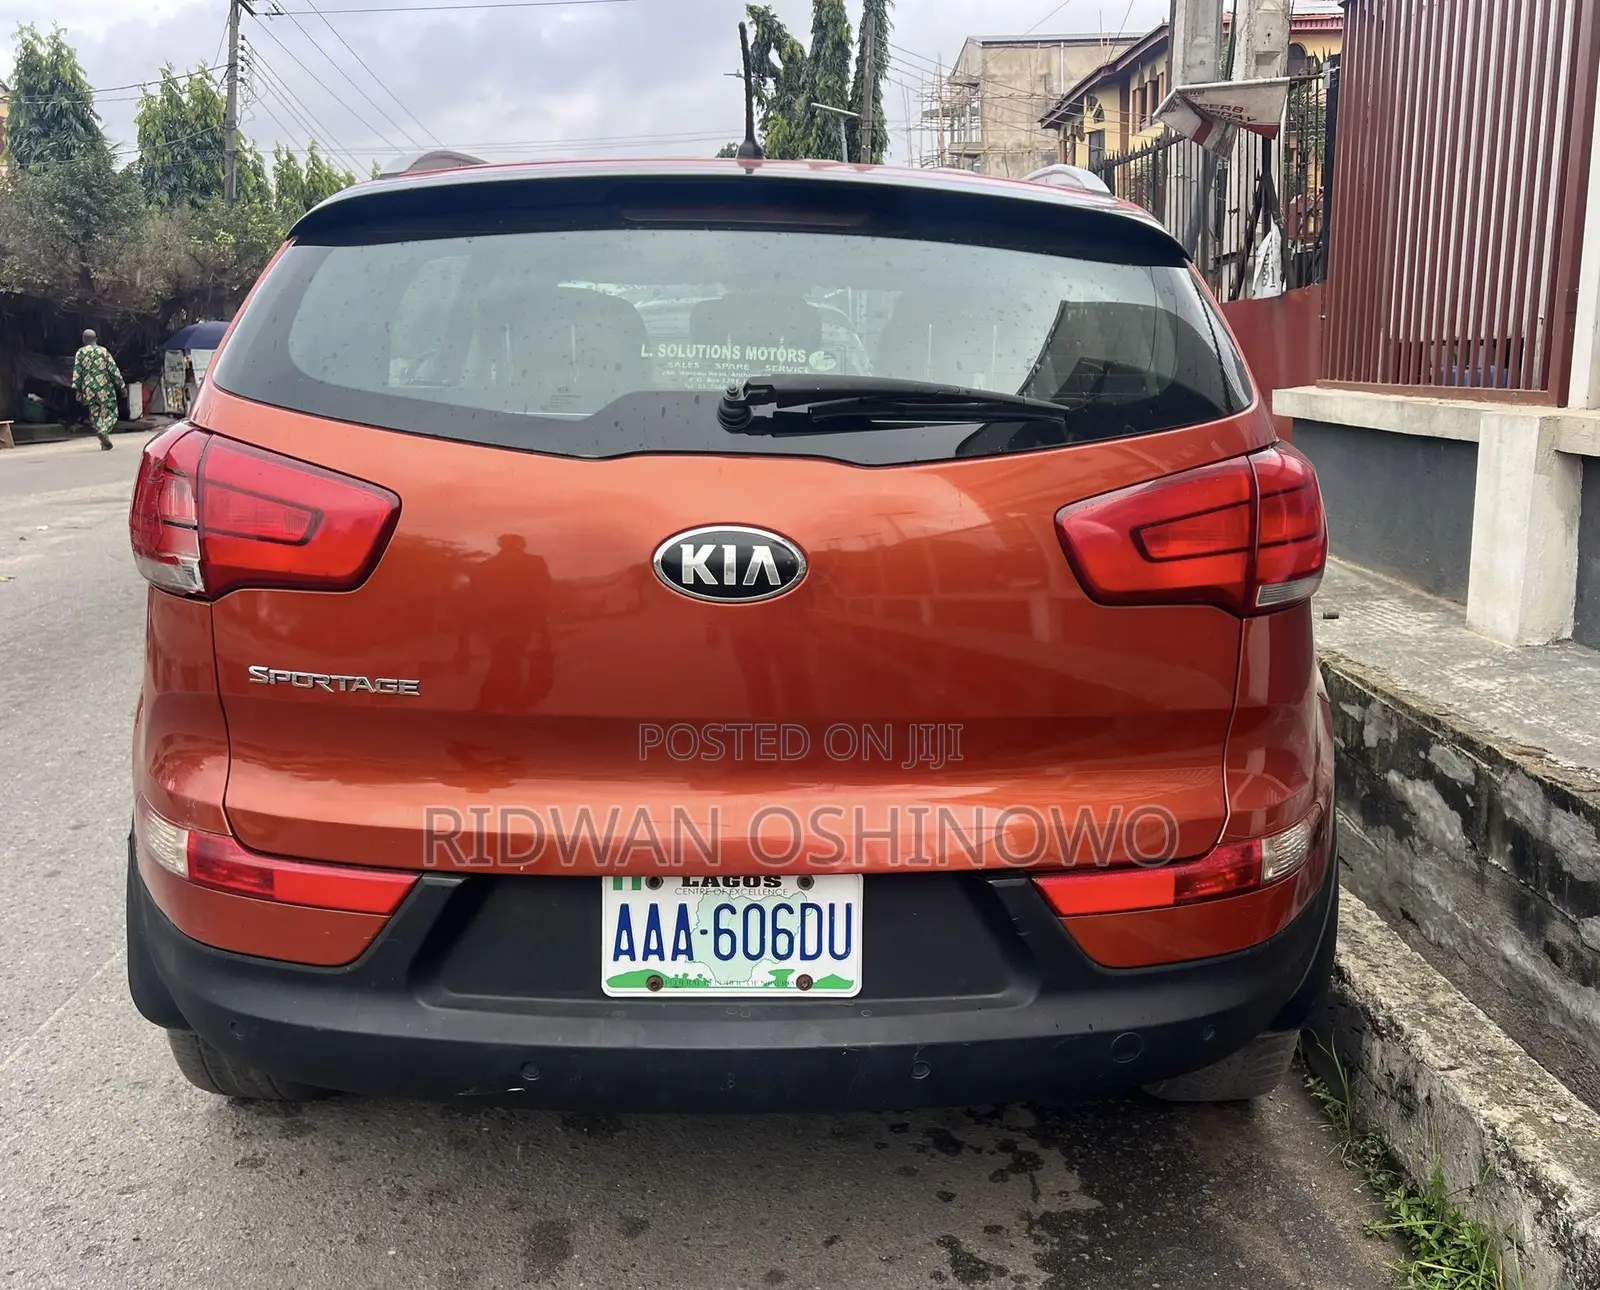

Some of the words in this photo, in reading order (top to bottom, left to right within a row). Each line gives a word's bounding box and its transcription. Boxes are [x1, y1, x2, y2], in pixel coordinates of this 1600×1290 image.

[640, 344, 653, 358] L.
[657, 344, 741, 360] SOLUTIONS
[745, 345, 807, 363] MOTORS
[667, 361, 700, 369] SALES
[715, 363, 750, 371] SPARE
[765, 364, 811, 374] SERVICE
[680, 543, 782, 586] KIA
[248, 665, 421, 696] SPORTAGE
[681, 875, 783, 888] LAGOS
[674, 887, 710, 896] CENTRE
[713, 888, 726, 896] OF
[729, 888, 789, 896] EXCELLENCE
[612, 902, 853, 962] AAA-606DU
